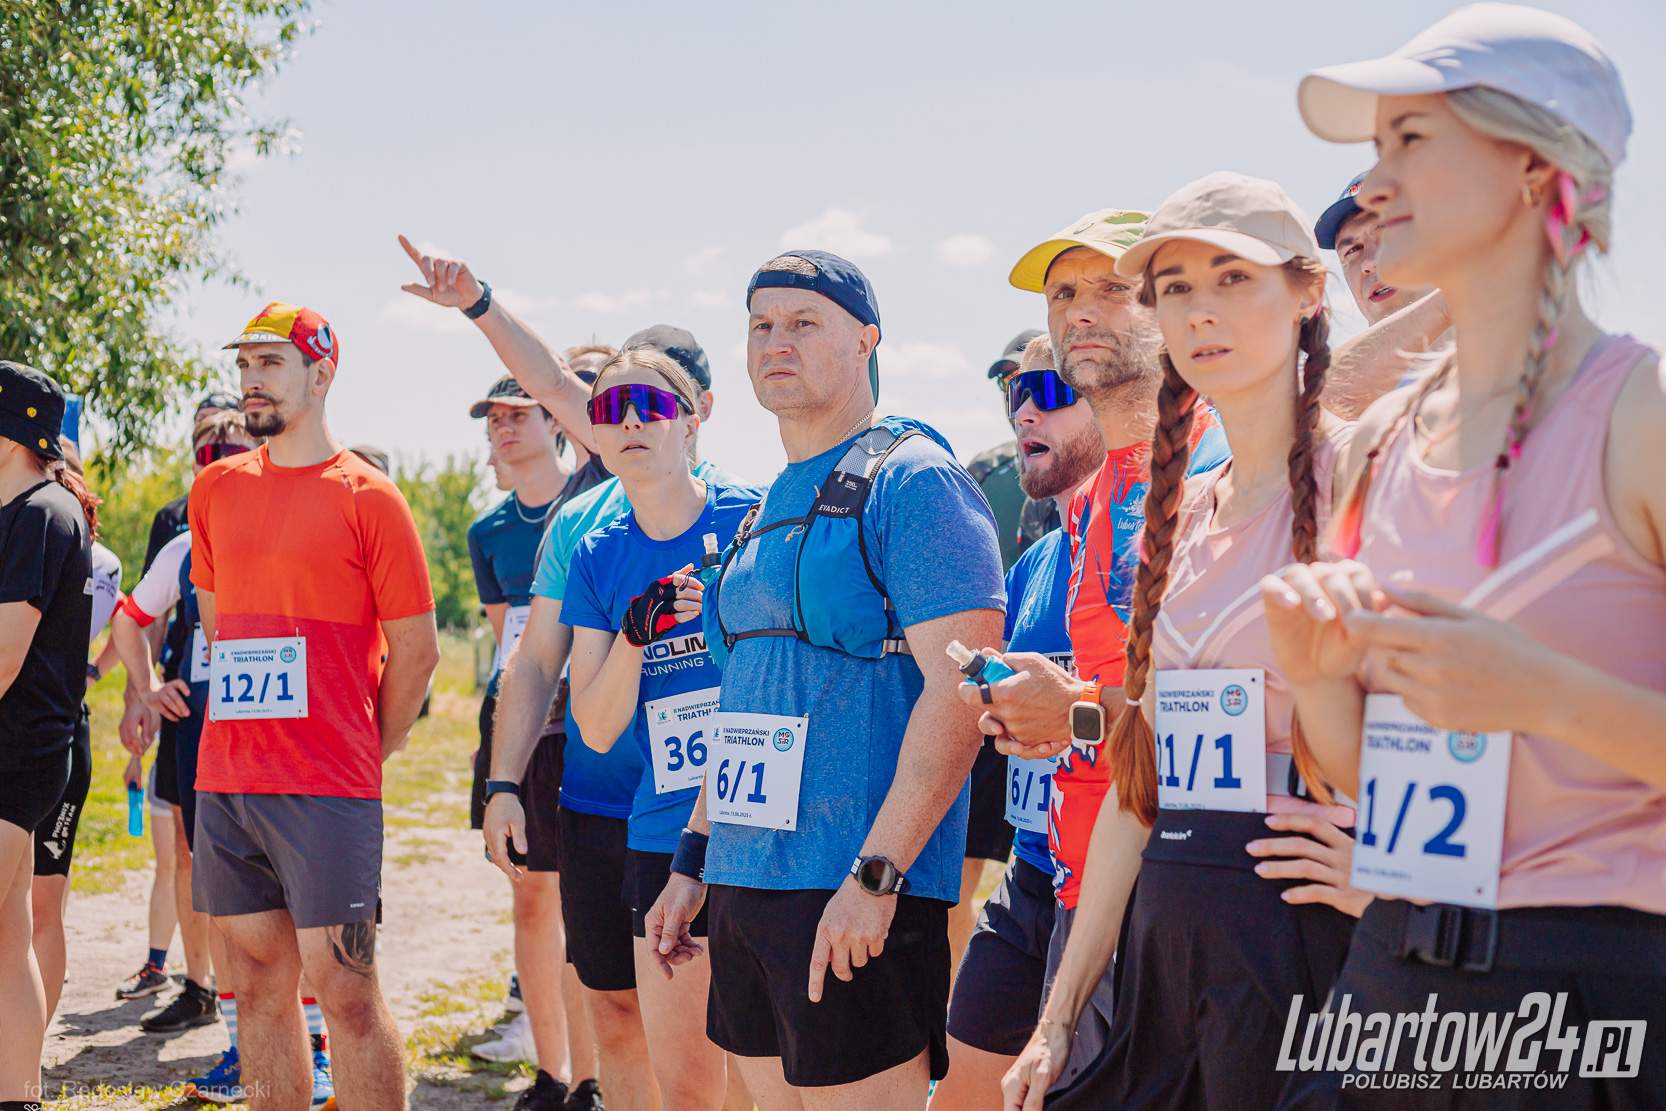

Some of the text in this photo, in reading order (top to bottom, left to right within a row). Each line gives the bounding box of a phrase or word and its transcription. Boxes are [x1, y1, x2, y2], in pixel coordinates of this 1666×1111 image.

[818, 504, 850, 514] EVADICT
[233, 655, 274, 663] TRIATHLON
[643, 636, 708, 661] NOLIM
[221, 672, 294, 704] 12/1
[677, 700, 720, 713] NADWIEPRZA
[724, 735, 766, 747] TRIATHLON
[717, 758, 768, 805] 6/1
[1010, 766, 1051, 813] 6/1
[1361, 777, 1468, 859] 1/2
